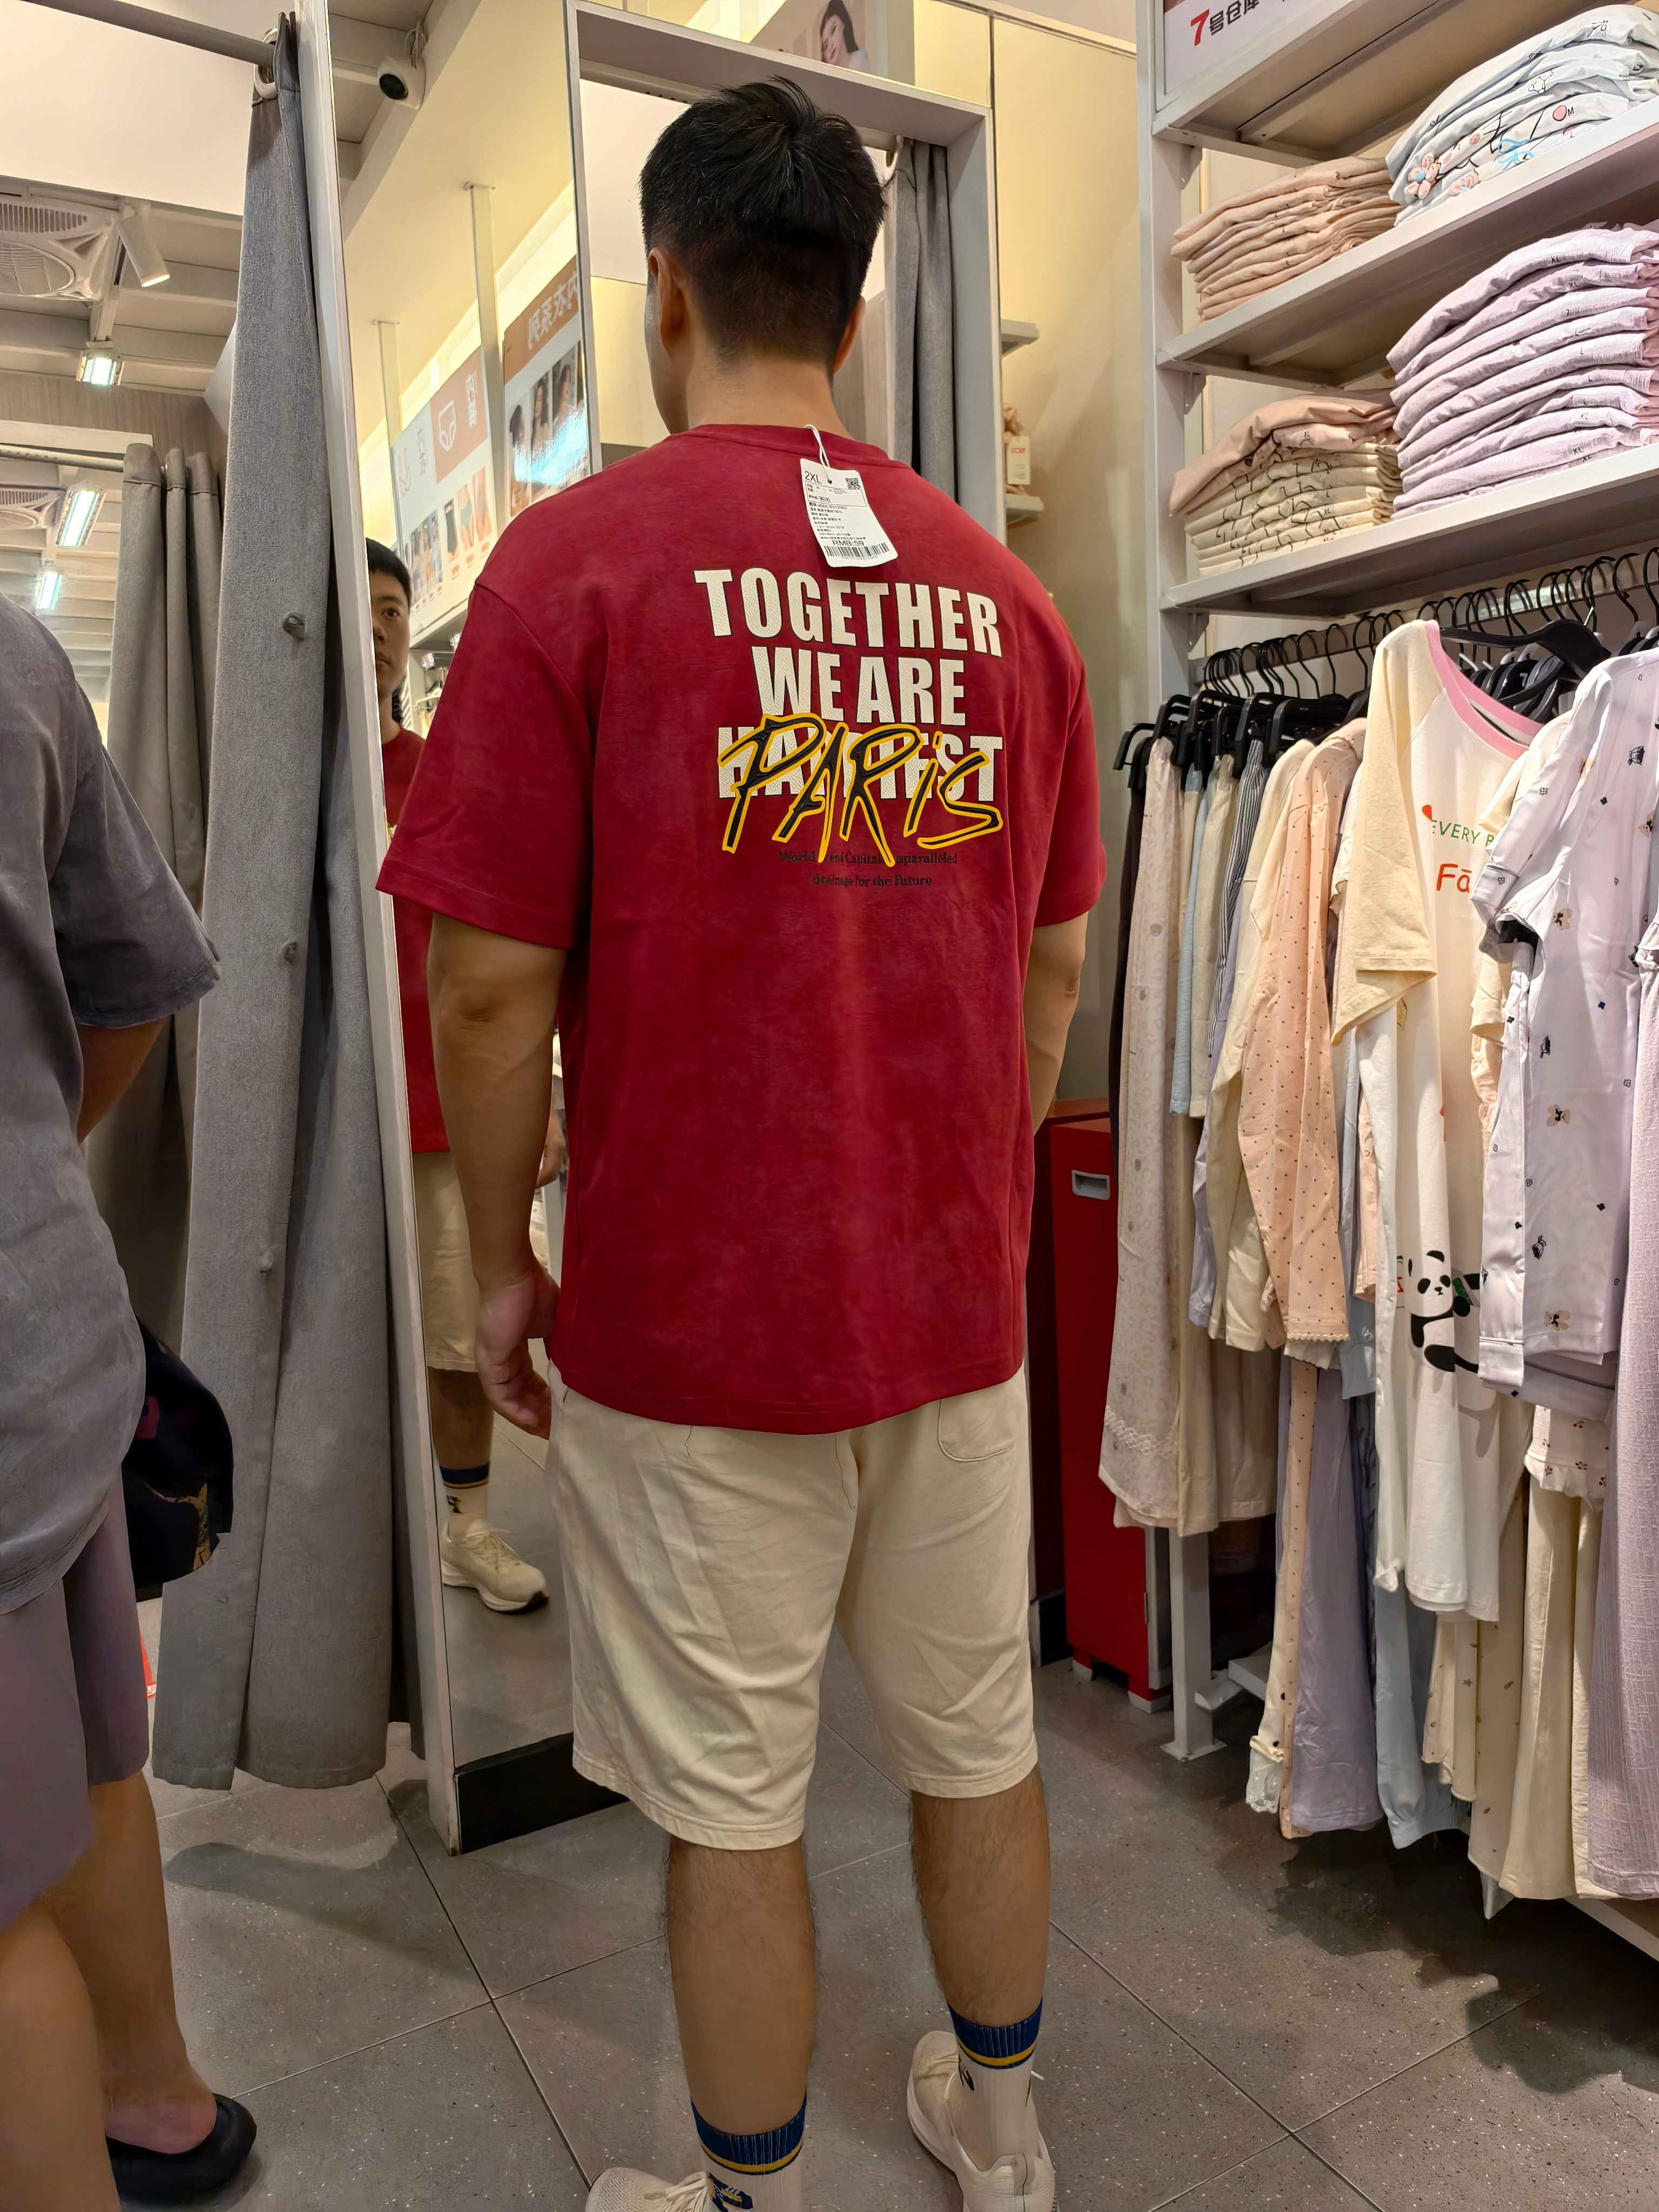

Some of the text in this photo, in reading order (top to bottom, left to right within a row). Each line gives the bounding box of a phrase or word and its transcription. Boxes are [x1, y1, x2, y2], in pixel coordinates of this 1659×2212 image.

[1550, 255, 1562, 264] XL
[805, 471, 822, 484] 2XL
[694, 568, 1002, 657] TOGETHER
[751, 646, 966, 726] WE ARE
[894, 874, 932, 886] Future
